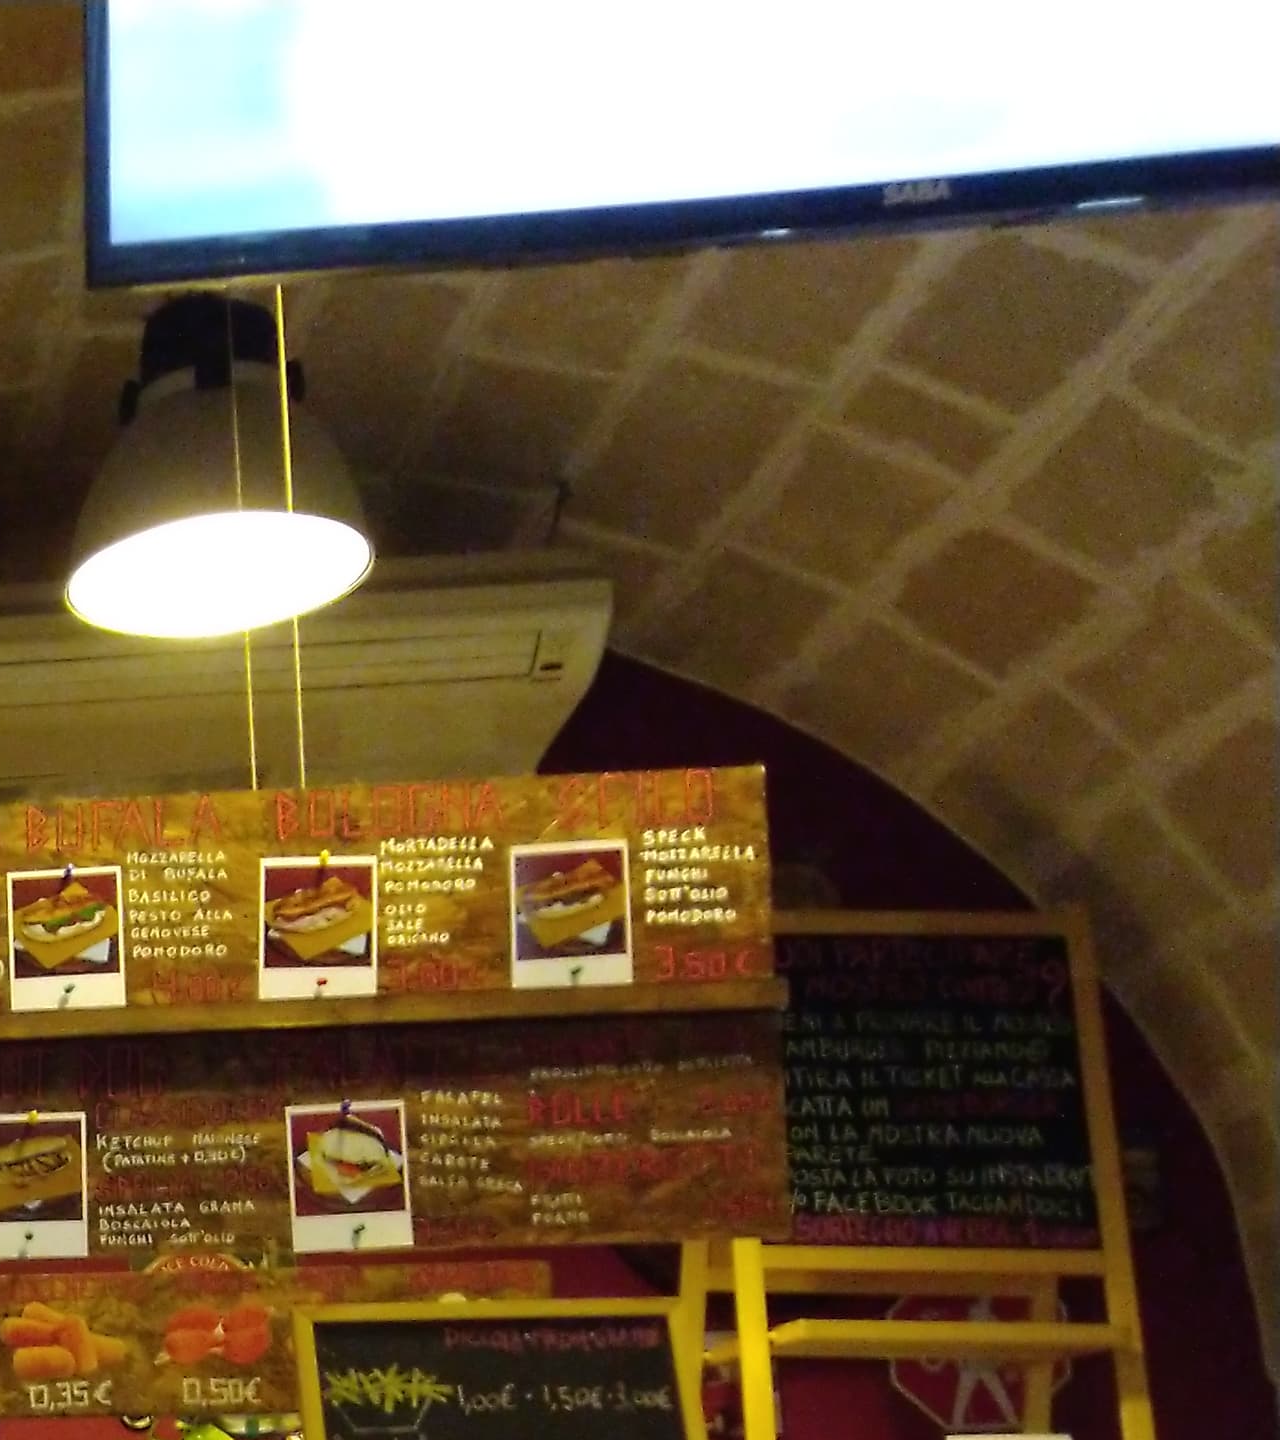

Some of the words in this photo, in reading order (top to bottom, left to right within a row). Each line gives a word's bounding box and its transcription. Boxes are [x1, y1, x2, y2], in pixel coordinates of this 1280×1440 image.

[274, 782, 505, 840] BOLOGNA
[26, 793, 221, 853] BUFALA
[643, 828, 707, 845] SPECK
[379, 836, 494, 857] MORTADELLA
[642, 846, 755, 862] MOZZARELLA
[127, 850, 225, 866] MOZZARELLA
[379, 857, 484, 874] MOZZARELLA
[129, 869, 146, 882] DI
[164, 867, 228, 882] BUFALA
[644, 868, 708, 883] FUNGHI
[384, 878, 476, 894] POMODORO
[128, 889, 211, 905] BASILICO
[129, 909, 181, 924] PESTO
[193, 908, 233, 922] ALLA
[384, 903, 427, 917] OLIO
[645, 908, 738, 925] POMODORO
[131, 926, 210, 940] GENOVESE
[132, 944, 228, 960] POMODORO
[99, 1201, 186, 1217] INSALATA
